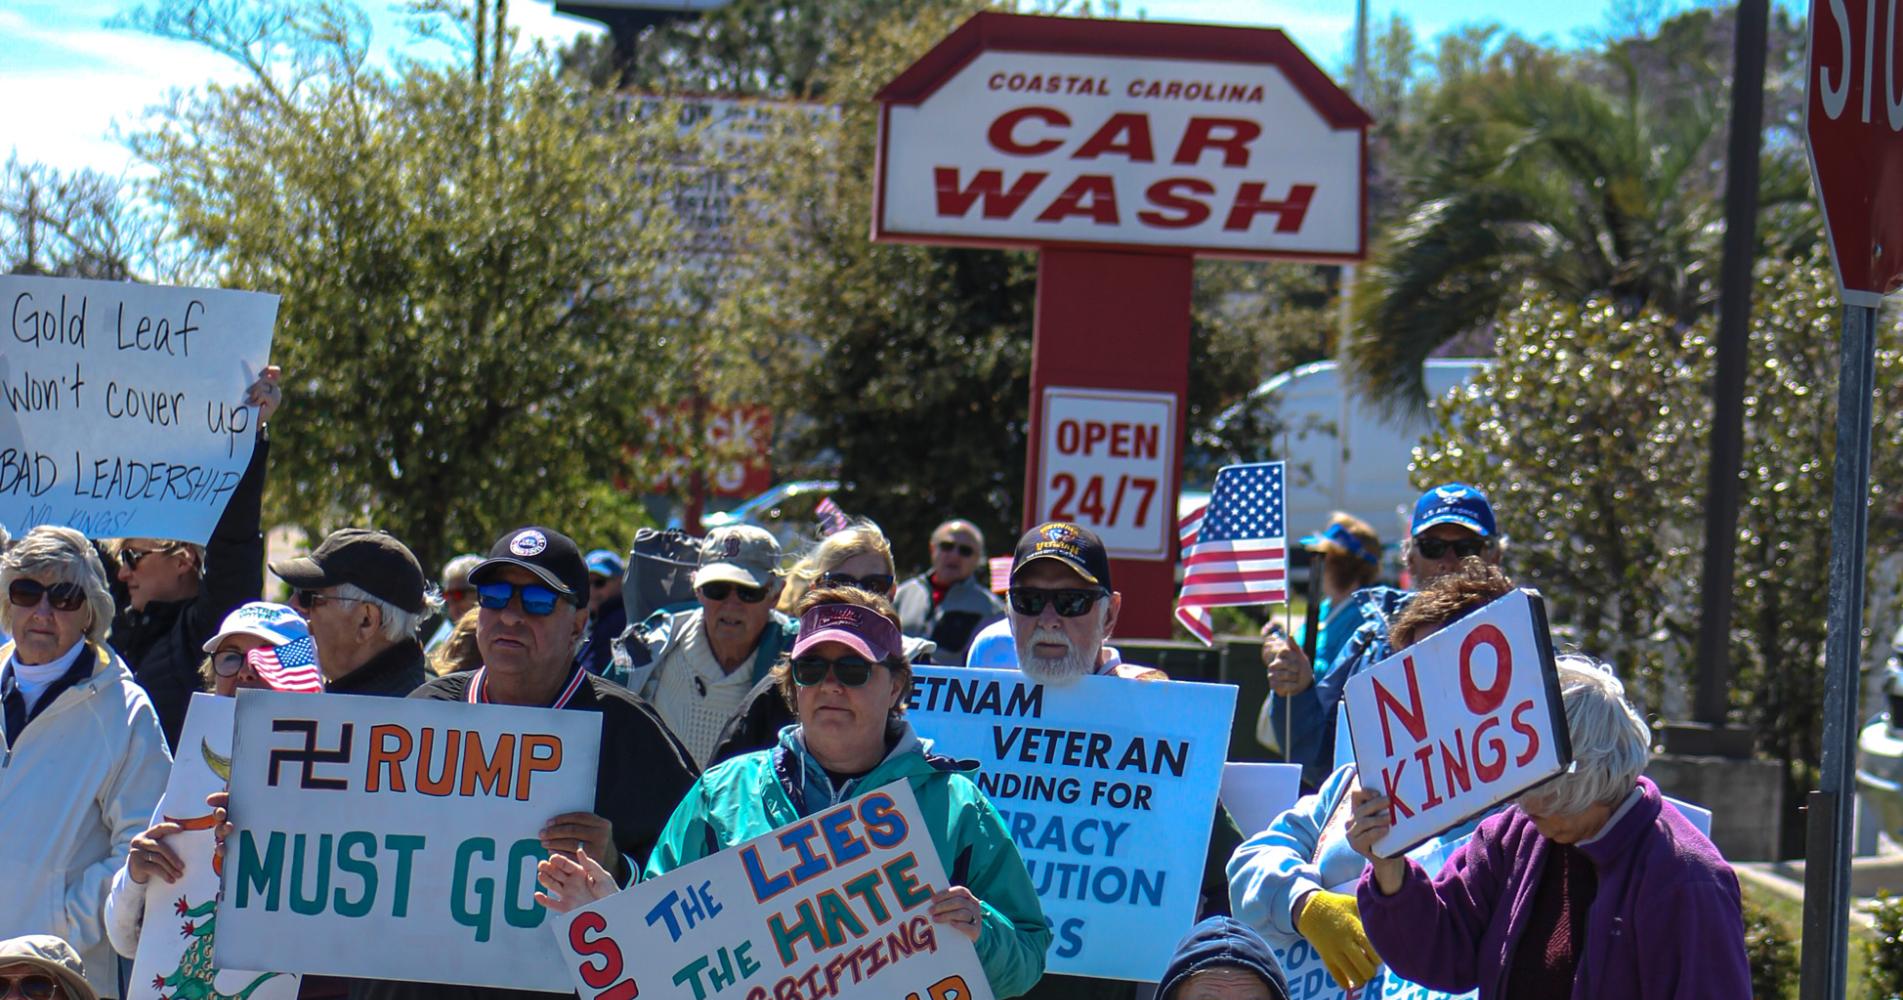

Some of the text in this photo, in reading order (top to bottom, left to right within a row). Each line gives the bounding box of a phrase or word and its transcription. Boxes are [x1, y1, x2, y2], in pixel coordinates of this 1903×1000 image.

[988, 72, 1266, 103] COASTAL CAROLINA
[987, 106, 1262, 168] CAR
[933, 166, 1318, 234] WASH
[12, 292, 205, 357] Gold Leaf
[106, 381, 185, 426] cover
[207, 401, 249, 459] up
[1055, 418, 1160, 460] OPEN
[0, 448, 241, 506] BAD LEADERSHIP
[1050, 471, 1158, 528] 24/7
[906, 675, 1045, 719] ETNAM
[1371, 623, 1513, 758] NO
[364, 723, 563, 801] RUMP
[993, 725, 1190, 777] VETERAN
[1381, 699, 1541, 827] KINGS
[978, 772, 1153, 811] NDING FOR
[1003, 810, 1130, 857] RACY
[235, 829, 549, 943] MUST GO
[644, 791, 910, 943] THE LIES
[1027, 859, 1166, 907] UTION
[766, 850, 936, 968] HATE
